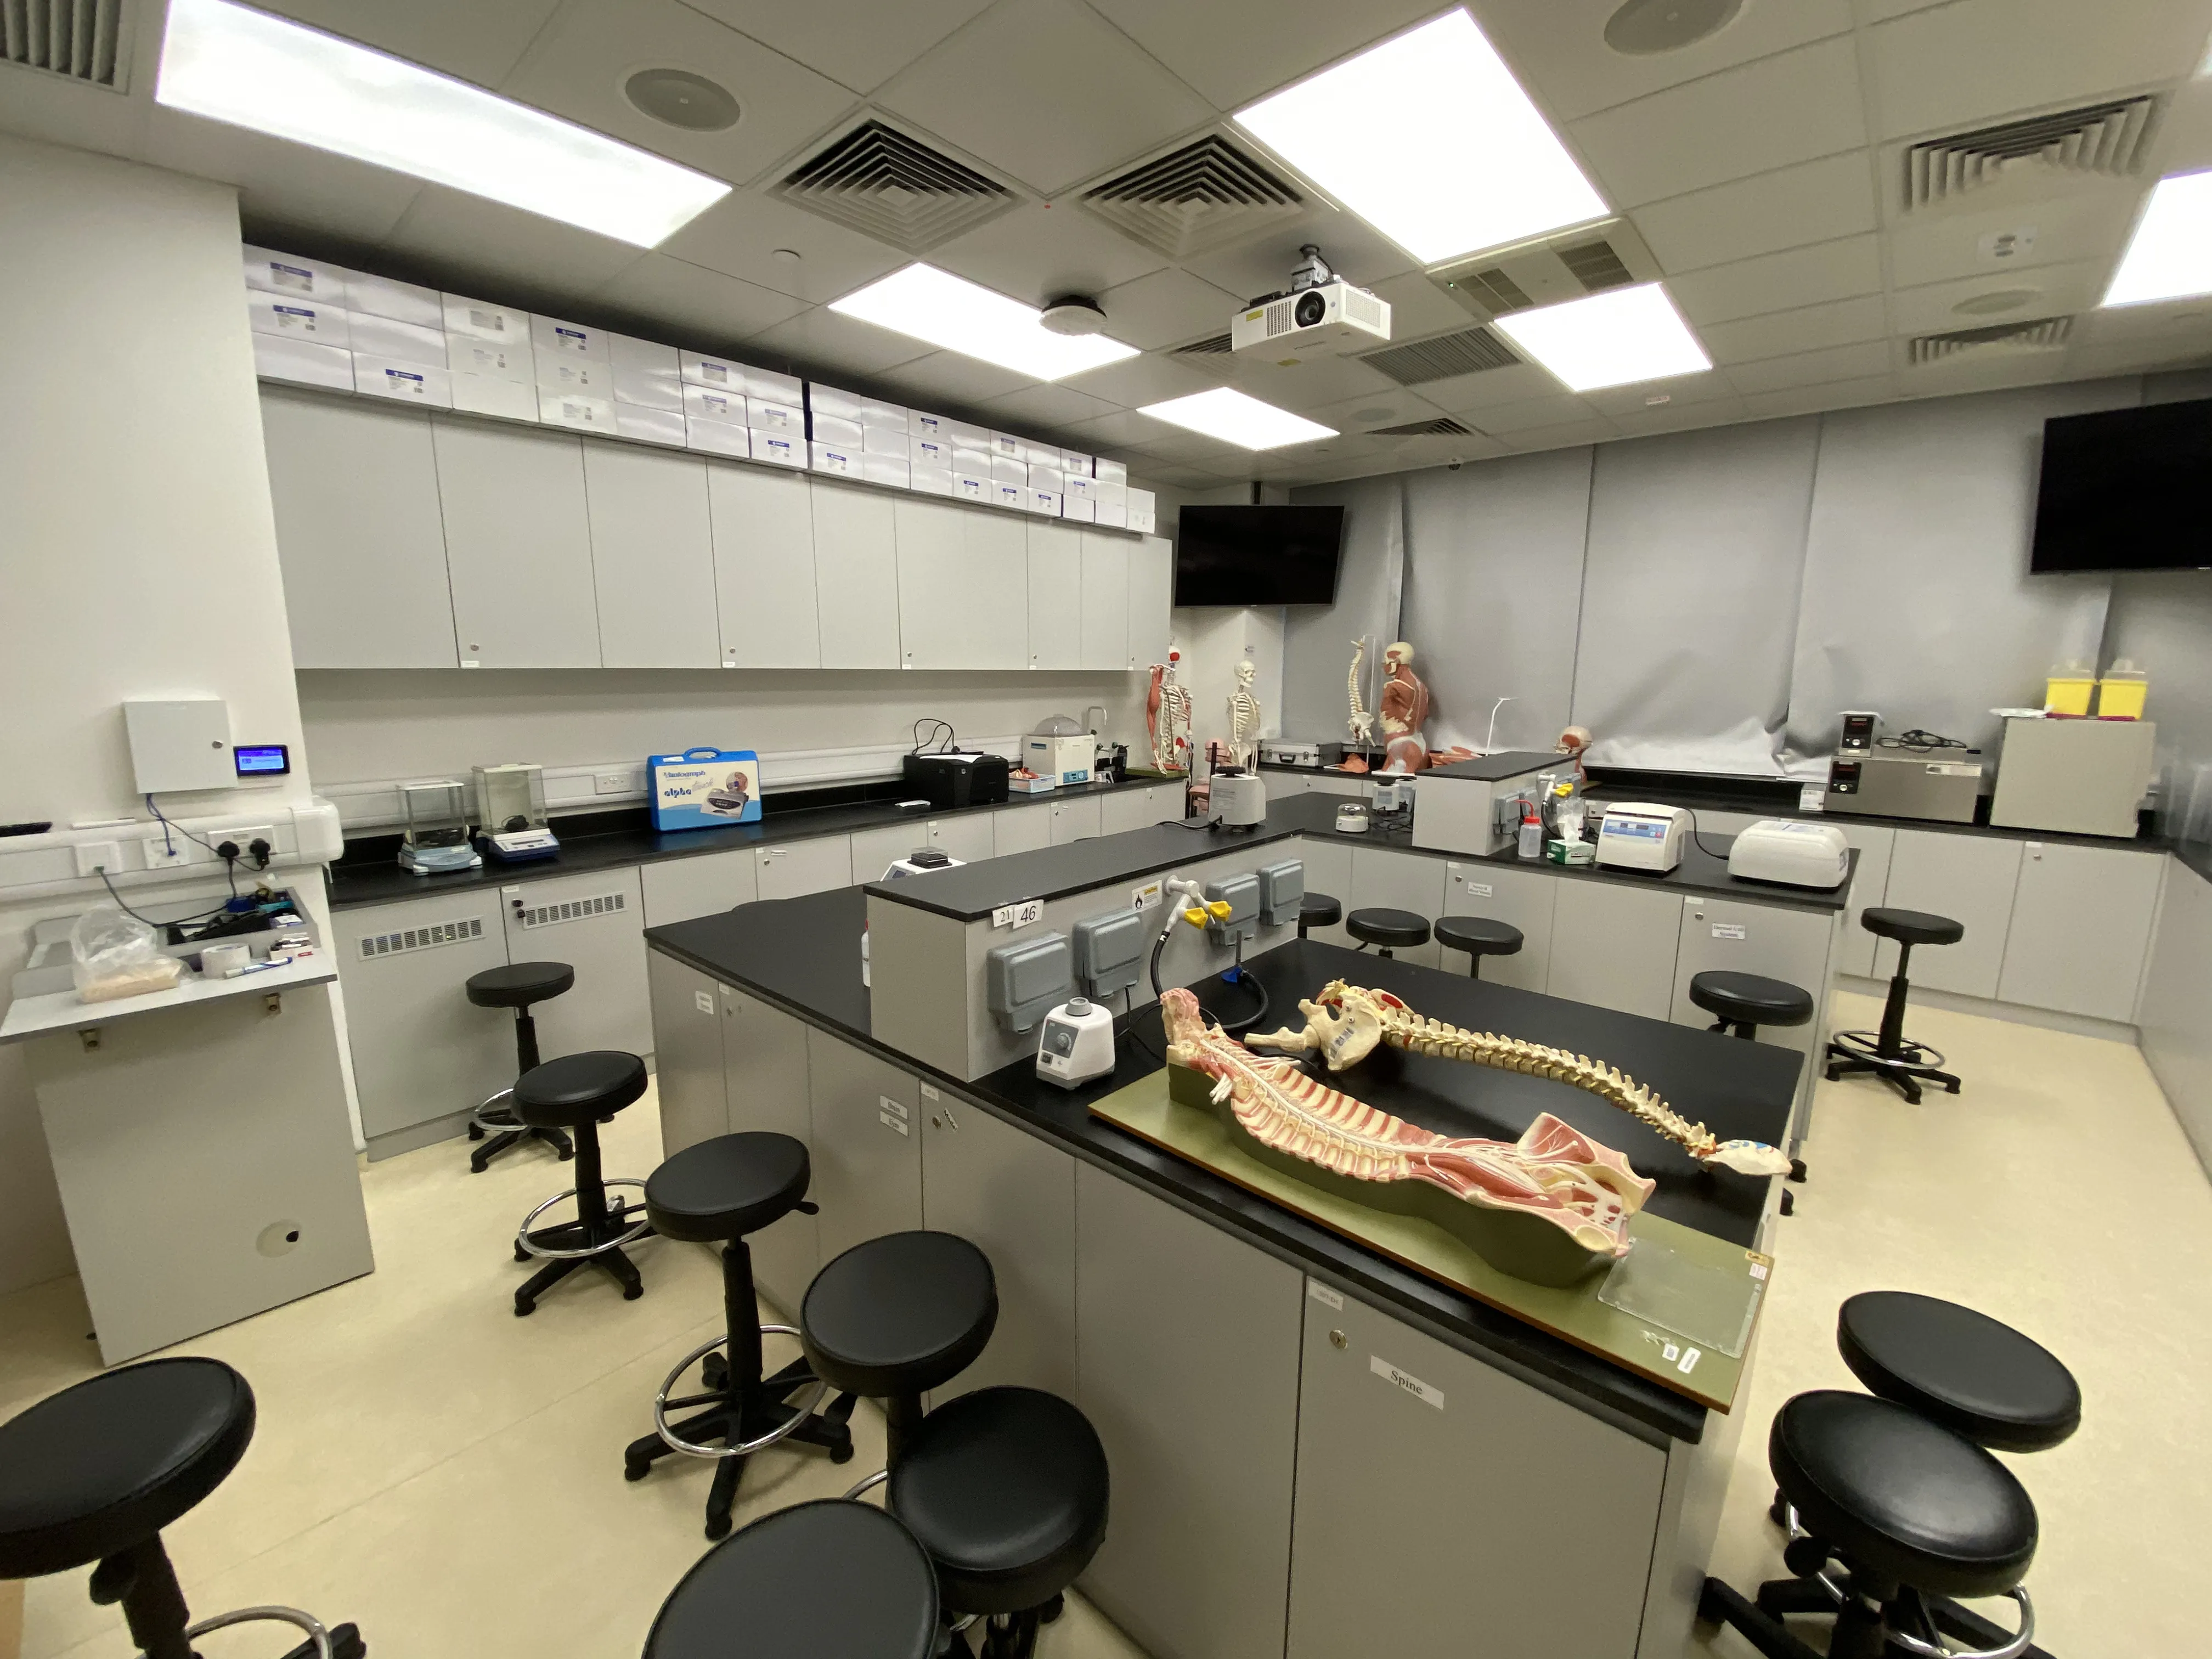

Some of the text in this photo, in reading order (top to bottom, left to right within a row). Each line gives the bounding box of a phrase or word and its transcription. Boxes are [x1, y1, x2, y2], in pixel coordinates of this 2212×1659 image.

[664, 788, 692, 798] alpha
[1000, 910, 1010, 922] 21
[1020, 905, 1036, 923] 46
[1391, 1370, 1423, 1395] Spine
